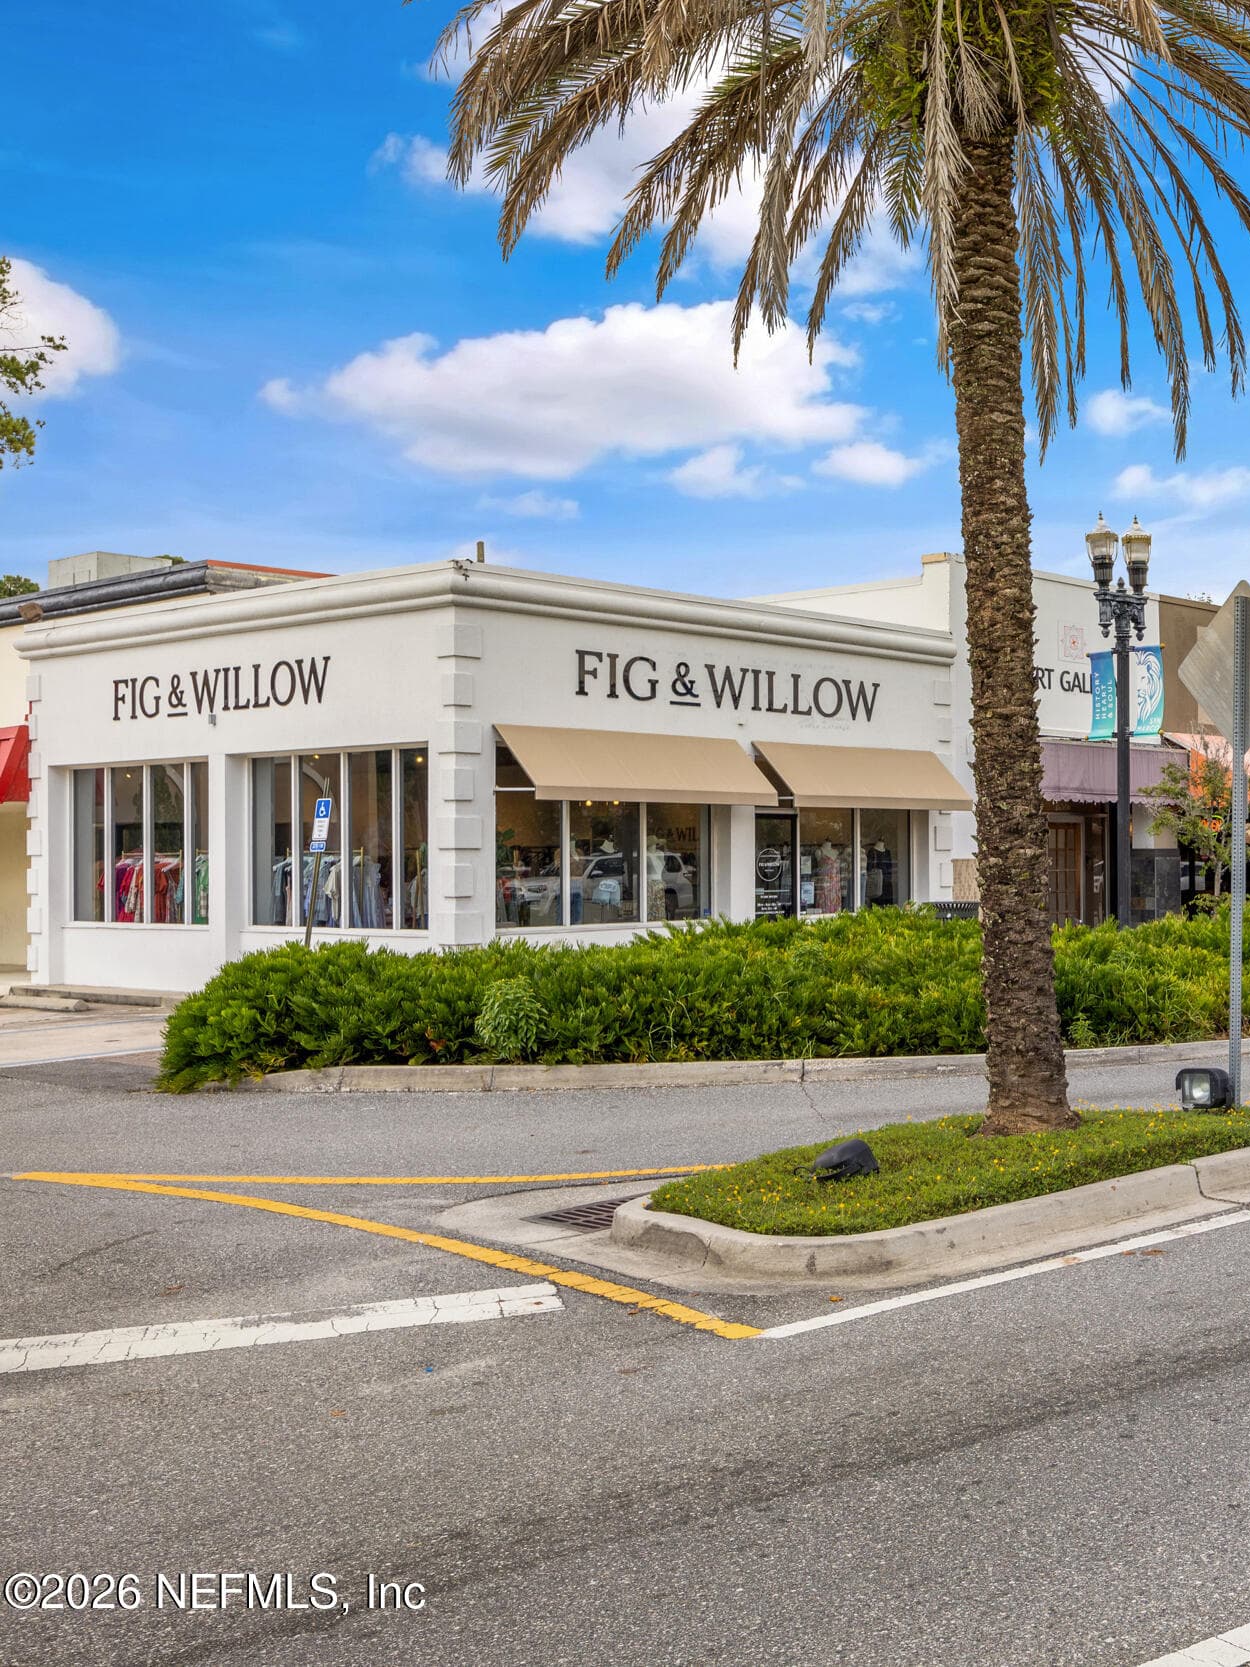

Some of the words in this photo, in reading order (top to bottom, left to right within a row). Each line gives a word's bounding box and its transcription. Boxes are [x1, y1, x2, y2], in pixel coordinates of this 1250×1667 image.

[112, 676, 161, 721] FIG
[167, 674, 188, 717] &
[189, 656, 331, 715] WILLOW
[574, 649, 659, 701] FIG
[670, 661, 701, 707] &
[704, 663, 881, 722] WILLOW
[1034, 667, 1055, 690] RT
